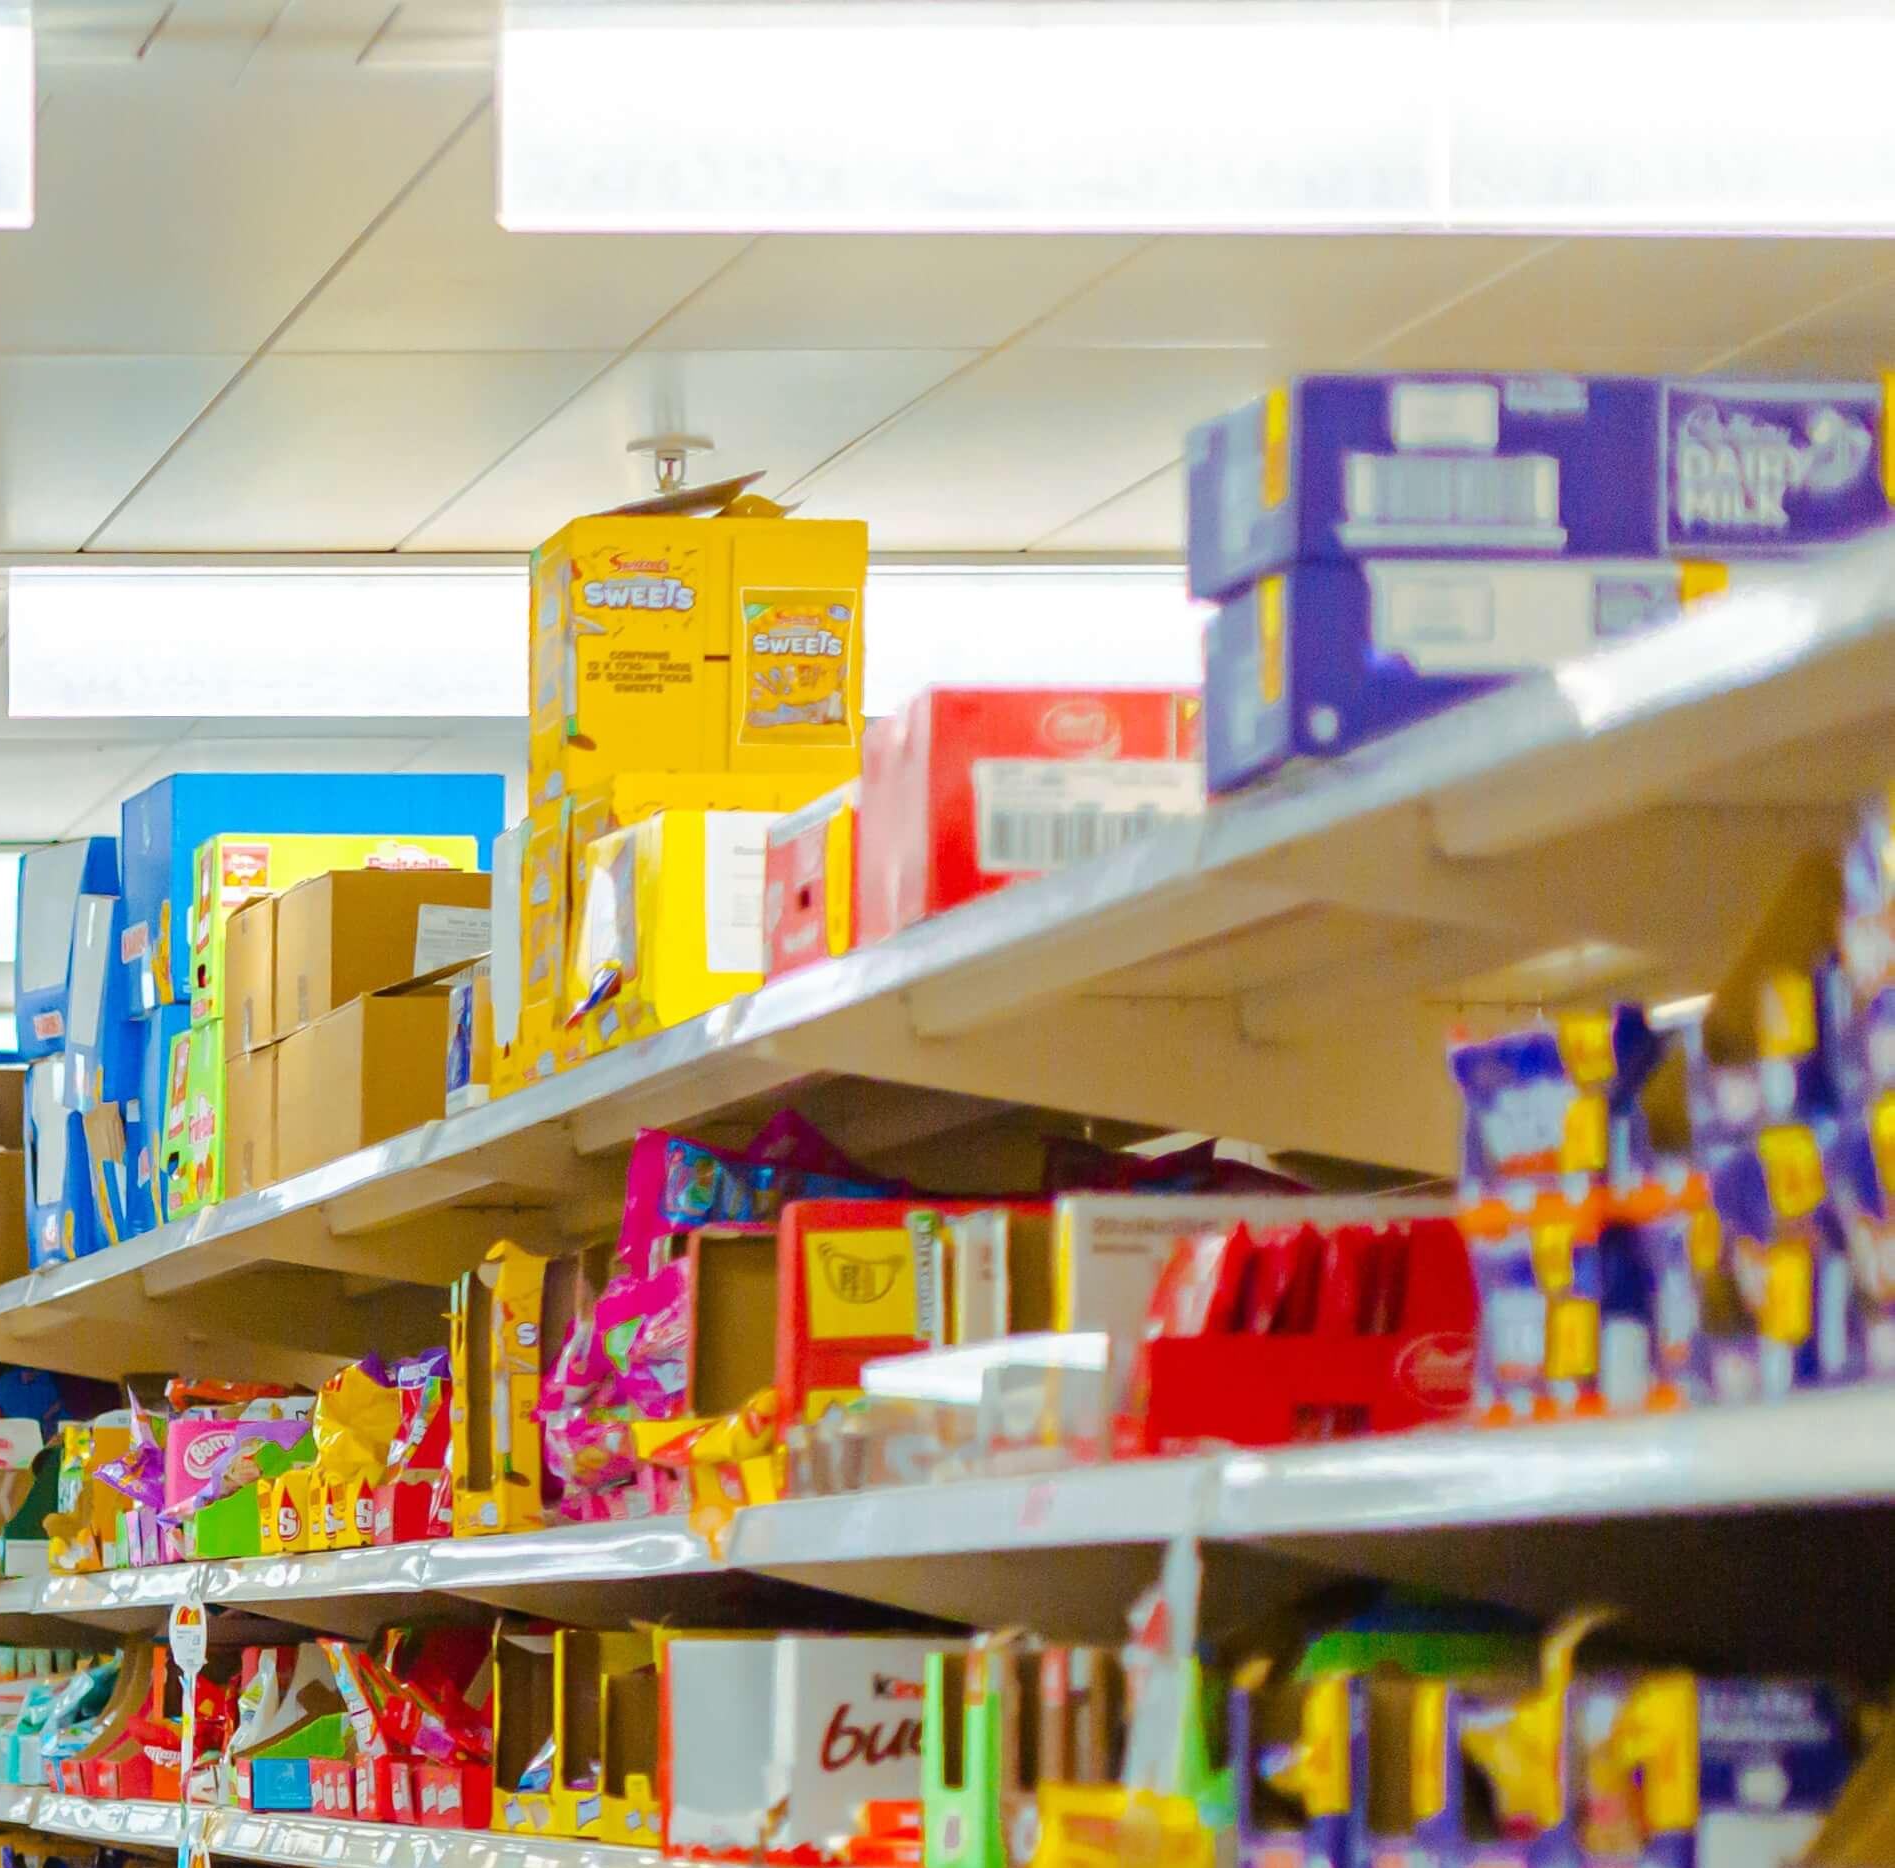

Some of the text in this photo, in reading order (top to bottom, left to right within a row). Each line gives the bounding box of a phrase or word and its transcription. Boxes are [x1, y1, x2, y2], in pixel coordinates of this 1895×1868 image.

[1678, 446, 1806, 486] DAIRY
[1679, 482, 1790, 528] MILK
[584, 578, 695, 611] SWEETS
[609, 651, 670, 662] CONTAINS
[753, 630, 842, 657] SWEETS
[605, 671, 693, 684] SCRUMPTIOUS
[614, 683, 664, 694] SWEETS
